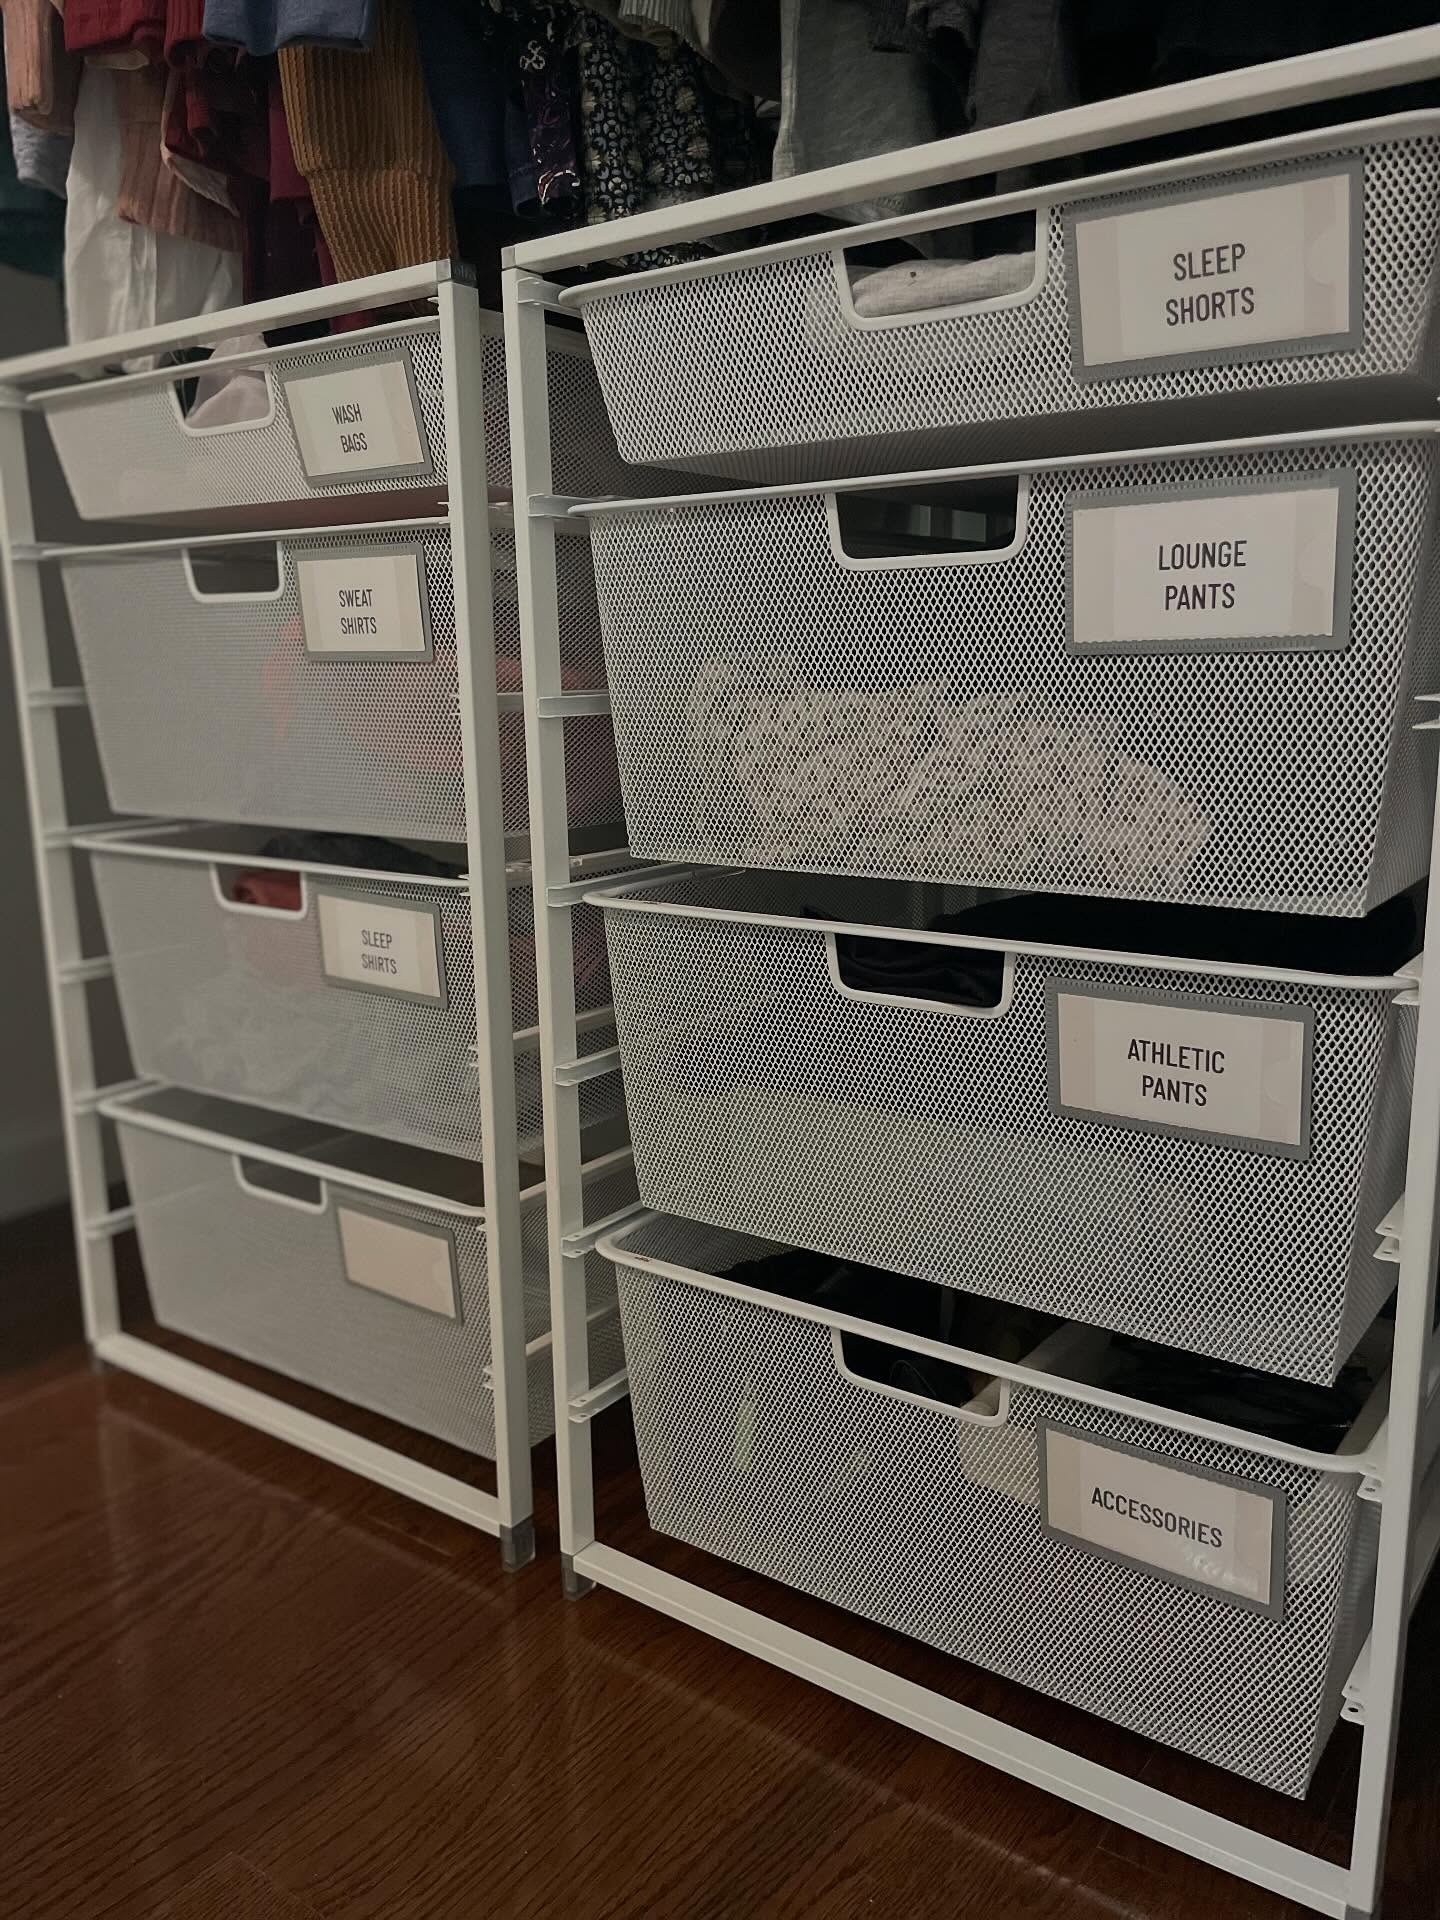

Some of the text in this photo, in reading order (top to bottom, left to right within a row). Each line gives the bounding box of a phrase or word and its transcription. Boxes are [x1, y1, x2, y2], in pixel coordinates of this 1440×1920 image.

[1173, 243, 1245, 281] SLEEP
[1166, 287, 1254, 326] SHORTS
[332, 402, 363, 425] WASH
[340, 432, 368, 454] BAGS
[1159, 540, 1247, 570] LOUNGE
[338, 588, 373, 607] SWEAT
[1166, 583, 1235, 611] PANTS
[341, 616, 377, 635] SHIRTS
[361, 929, 393, 950] SLEEP
[361, 953, 397, 975] SHIRTS
[1127, 1038, 1225, 1074] ATHLETIC
[1142, 1074, 1207, 1107] PANTS
[1091, 1486, 1223, 1548] ACCESSORIES
